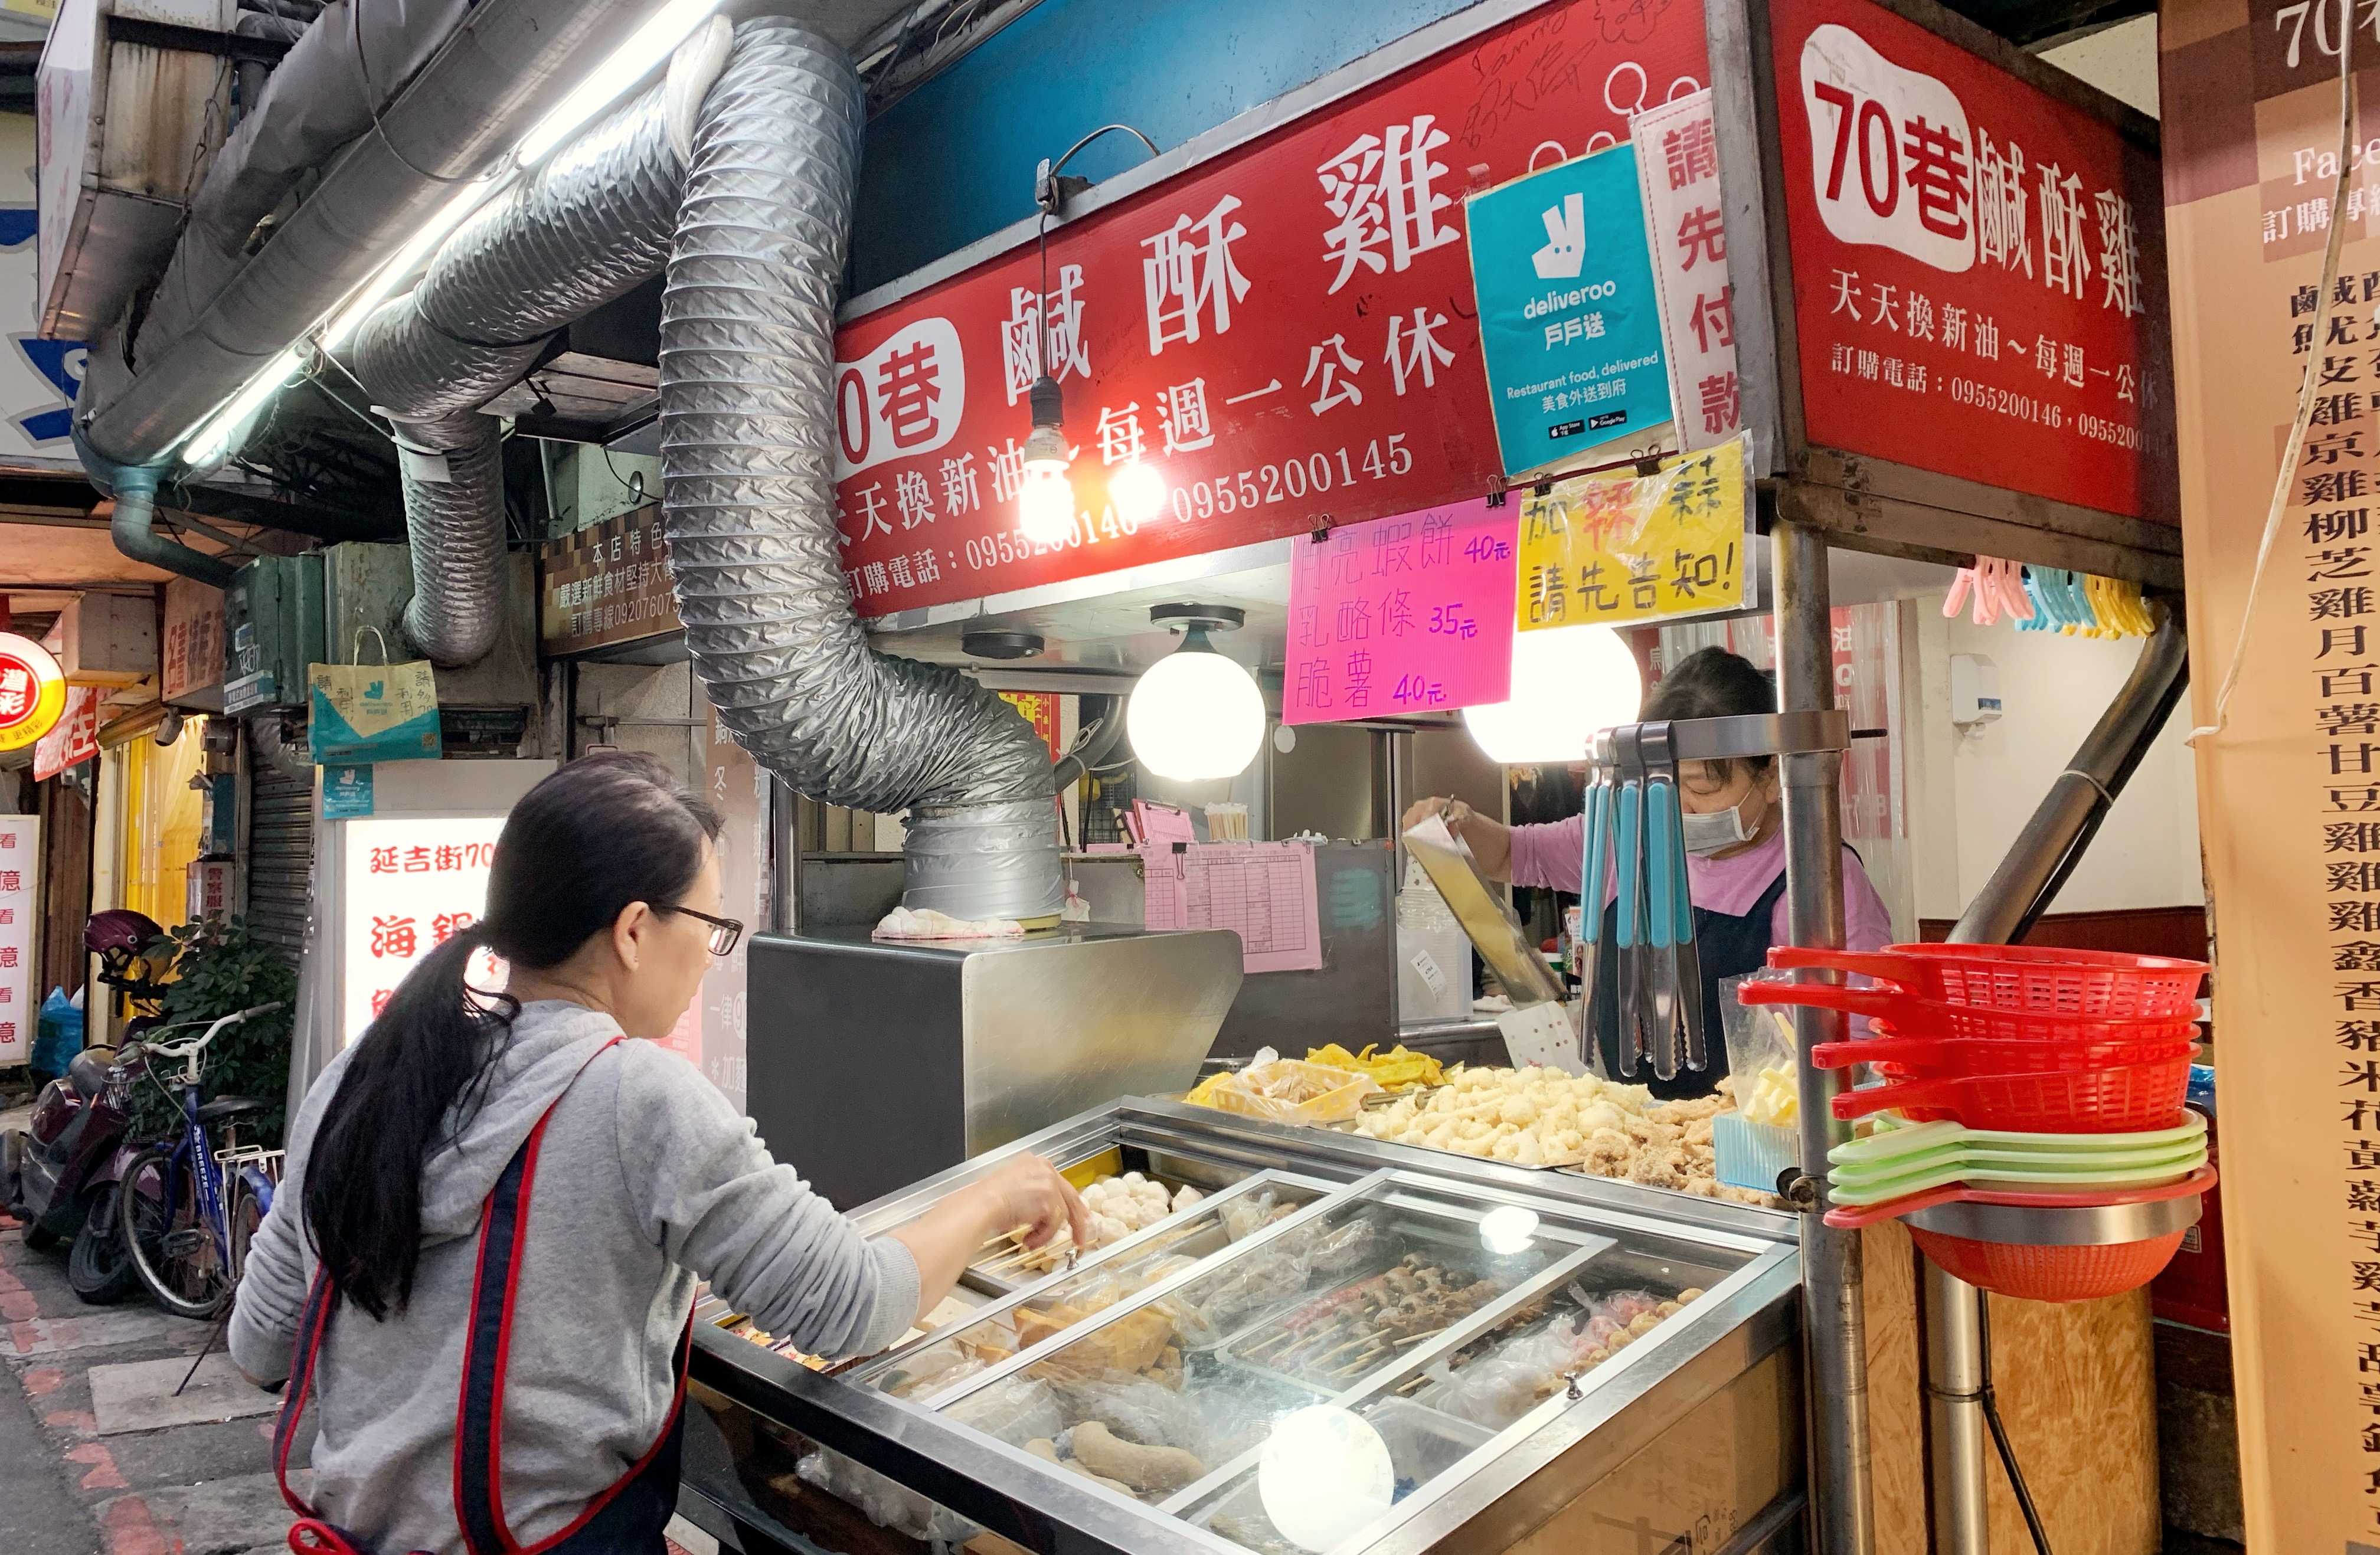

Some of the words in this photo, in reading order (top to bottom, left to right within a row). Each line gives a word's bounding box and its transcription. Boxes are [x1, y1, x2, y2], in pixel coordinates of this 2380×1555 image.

[1001, 114, 1461, 407] 鹹酥雞
[1663, 119, 1741, 435] 請先付款
[1524, 280, 1616, 319] deliveroo
[1545, 312, 1606, 351] 戶戶送
[1507, 375, 1567, 400] Restaurant
[1569, 366, 1600, 384] food,
[1601, 350, 1659, 376] delivered
[1542, 378, 1627, 414] 美食外送到府
[1172, 432, 1413, 523] 0955200145
[593, 522, 663, 568] 本店特色
[1301, 513, 1454, 590] 月亮蝦餅
[1464, 535, 1511, 564] 40元
[1299, 588, 1415, 648] 乳酪條
[1428, 603, 1478, 640] 35元
[1297, 647, 1372, 709] 脆薯
[1393, 673, 1447, 705] 40元
[370, 843, 496, 874] 延吉街70
[195, 1145, 209, 1188] BREEZE
